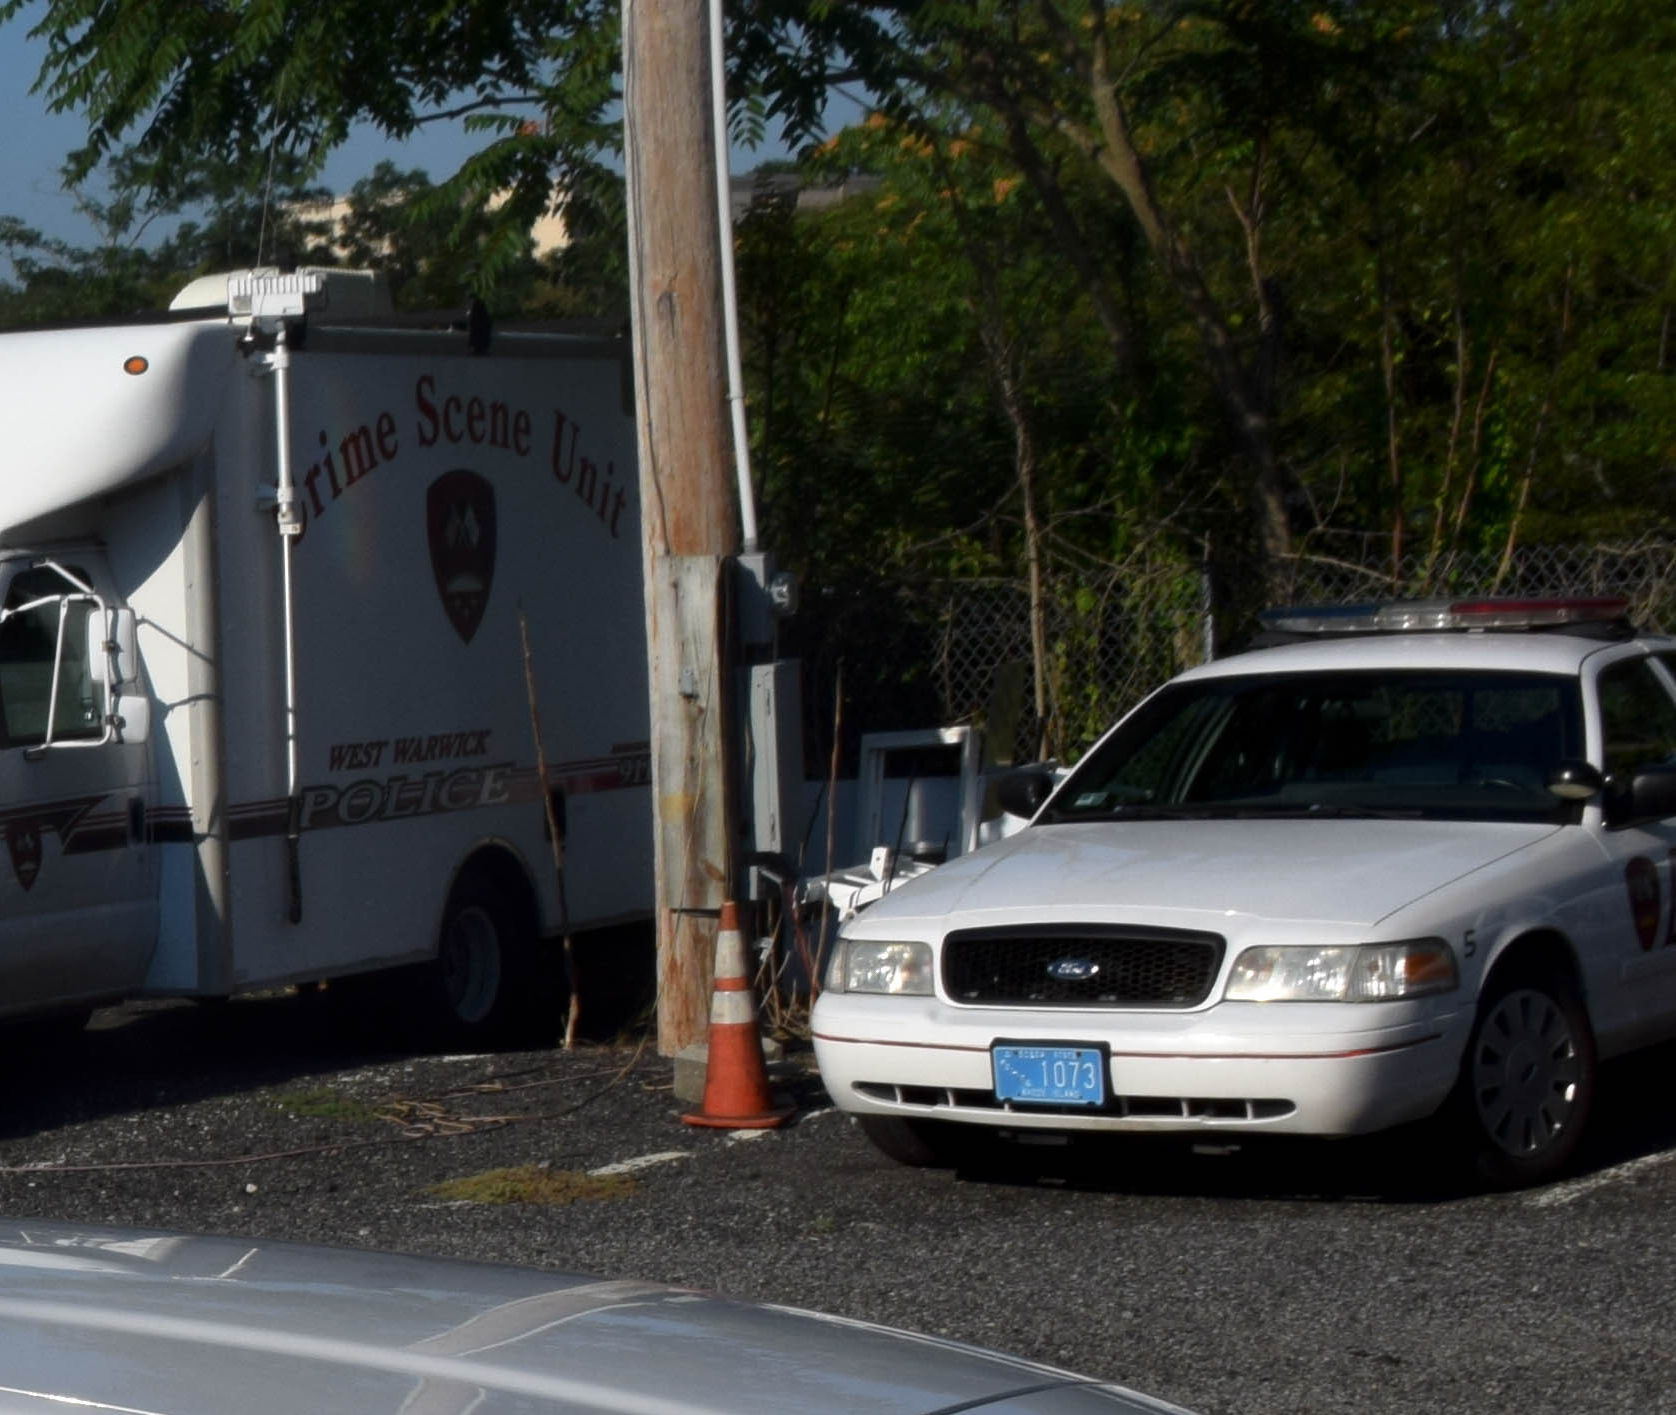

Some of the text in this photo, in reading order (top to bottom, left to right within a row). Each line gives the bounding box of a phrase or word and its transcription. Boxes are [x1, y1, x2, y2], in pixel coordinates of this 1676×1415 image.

[415, 375, 532, 456] Scene
[551, 408, 627, 539] Unit
[328, 730, 492, 772] WEST WARWICK
[299, 761, 515, 829] POLICE
[1463, 929, 1477, 958] 5
[1041, 1060, 1096, 1089] 1073
